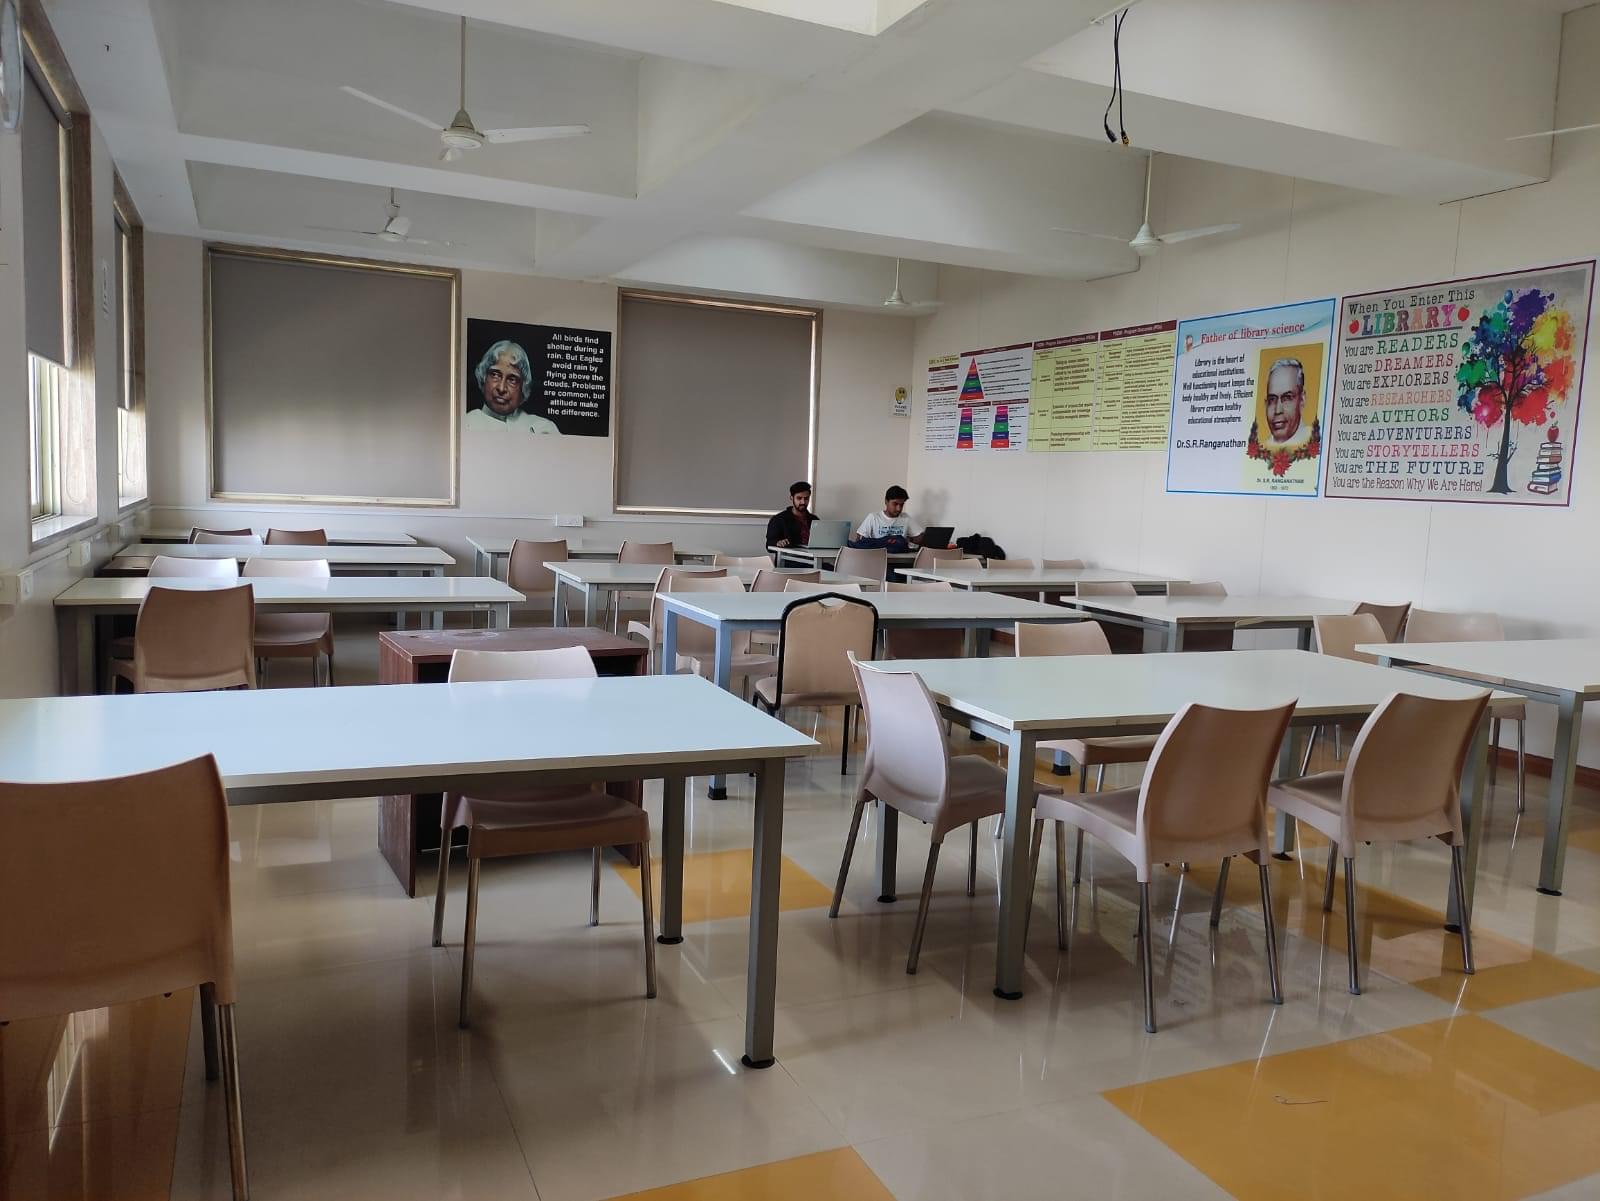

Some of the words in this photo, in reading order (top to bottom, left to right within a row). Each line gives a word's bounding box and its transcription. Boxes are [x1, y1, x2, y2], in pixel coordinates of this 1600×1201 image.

[1349, 303, 1378, 315] When
[1384, 300, 1404, 310] You
[1410, 294, 1444, 306] Enter
[1448, 289, 1475, 302] This
[1362, 304, 1456, 336] LIBRARY
[552, 333, 562, 341] All
[564, 334, 582, 342] birds
[1200, 332, 1226, 344] Father
[1228, 330, 1238, 340] of
[1240, 328, 1270, 339] library
[1272, 323, 1304, 335] science
[546, 342, 572, 350] shelter
[574, 345, 598, 354] during
[1344, 346, 1360, 358] You
[1360, 345, 1374, 356] are
[1376, 332, 1459, 355] READERS
[580, 354, 604, 364] Eagles
[1226, 355, 1238, 364] heart
[1344, 364, 1358, 374] You
[1358, 362, 1372, 374] are
[1374, 353, 1454, 372] DREAMERS
[546, 370, 566, 380] flying
[568, 372, 590, 380] above
[590, 364, 598, 373] by
[544, 380, 570, 388] clouds.
[572, 382, 606, 390] Problems
[1218, 380, 1230, 388] heart
[1342, 379, 1356, 390] You
[1357, 380, 1372, 390] are
[1372, 371, 1449, 389] EXPLORERS
[558, 392, 591, 400] common,
[1234, 390, 1254, 398] Efficient
[1340, 396, 1354, 408] You
[1355, 397, 1369, 407] are
[1370, 389, 1452, 406] RESEARCHERS
[562, 408, 600, 418] difference.
[1339, 414, 1352, 424] You
[1354, 414, 1368, 424] are
[1370, 408, 1450, 424] AUTHORS
[1338, 430, 1350, 442] You
[1352, 430, 1366, 441] are
[1368, 426, 1472, 441] ADVENTURERS
[1336, 448, 1352, 458] You
[1352, 448, 1364, 458] are
[1366, 443, 1480, 458] STORYTELLERS
[1334, 462, 1348, 474] You
[1350, 462, 1363, 474] are
[1366, 461, 1400, 474] THE
[1406, 462, 1484, 475] FUTURE
[1332, 476, 1346, 488] You
[1346, 478, 1360, 488] are
[1362, 478, 1374, 488] the
[1376, 478, 1404, 490] Reason
[1406, 478, 1425, 492] Why
[1427, 478, 1438, 490] We
[1440, 480, 1458, 490] Are
[1460, 479, 1483, 492] Here!
